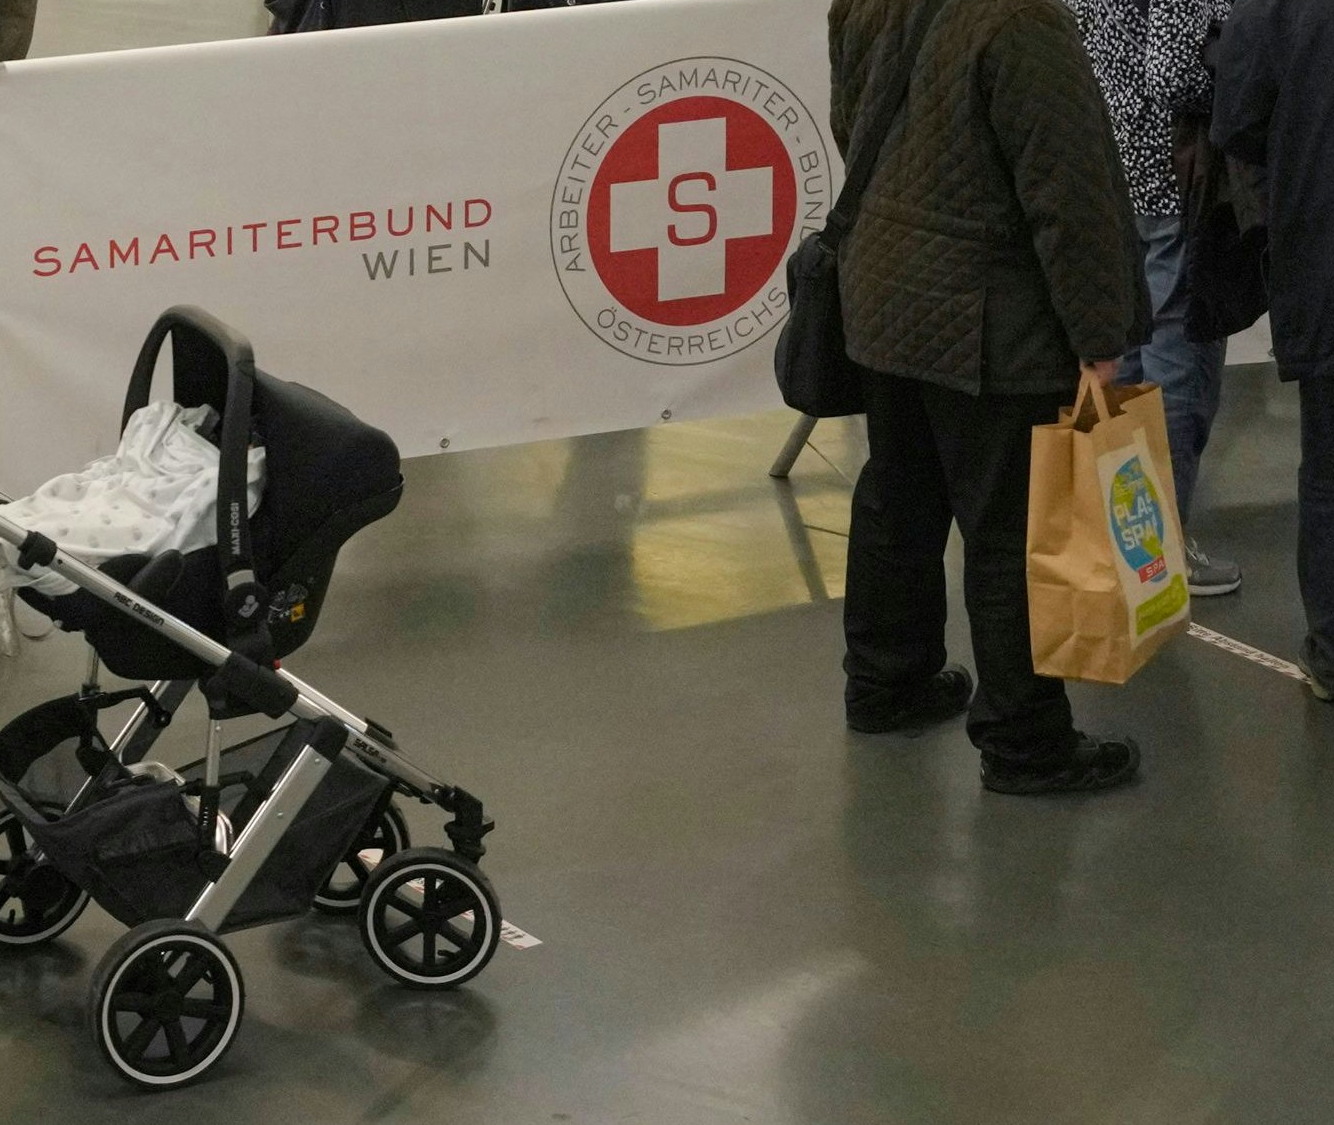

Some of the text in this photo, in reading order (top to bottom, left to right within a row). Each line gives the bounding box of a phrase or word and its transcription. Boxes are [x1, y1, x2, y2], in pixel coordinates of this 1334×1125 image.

[559, 113, 619, 274] ARBEITER
[636, 67, 800, 131] SAMARITER
[33, 198, 493, 277] SAMARITERBUND
[667, 171, 718, 247] S
[362, 239, 491, 281] WIEN
[596, 286, 788, 356] ÖSTERREICHS
[114, 591, 133, 608] ABC
[1145, 559, 1165, 578] SPA
